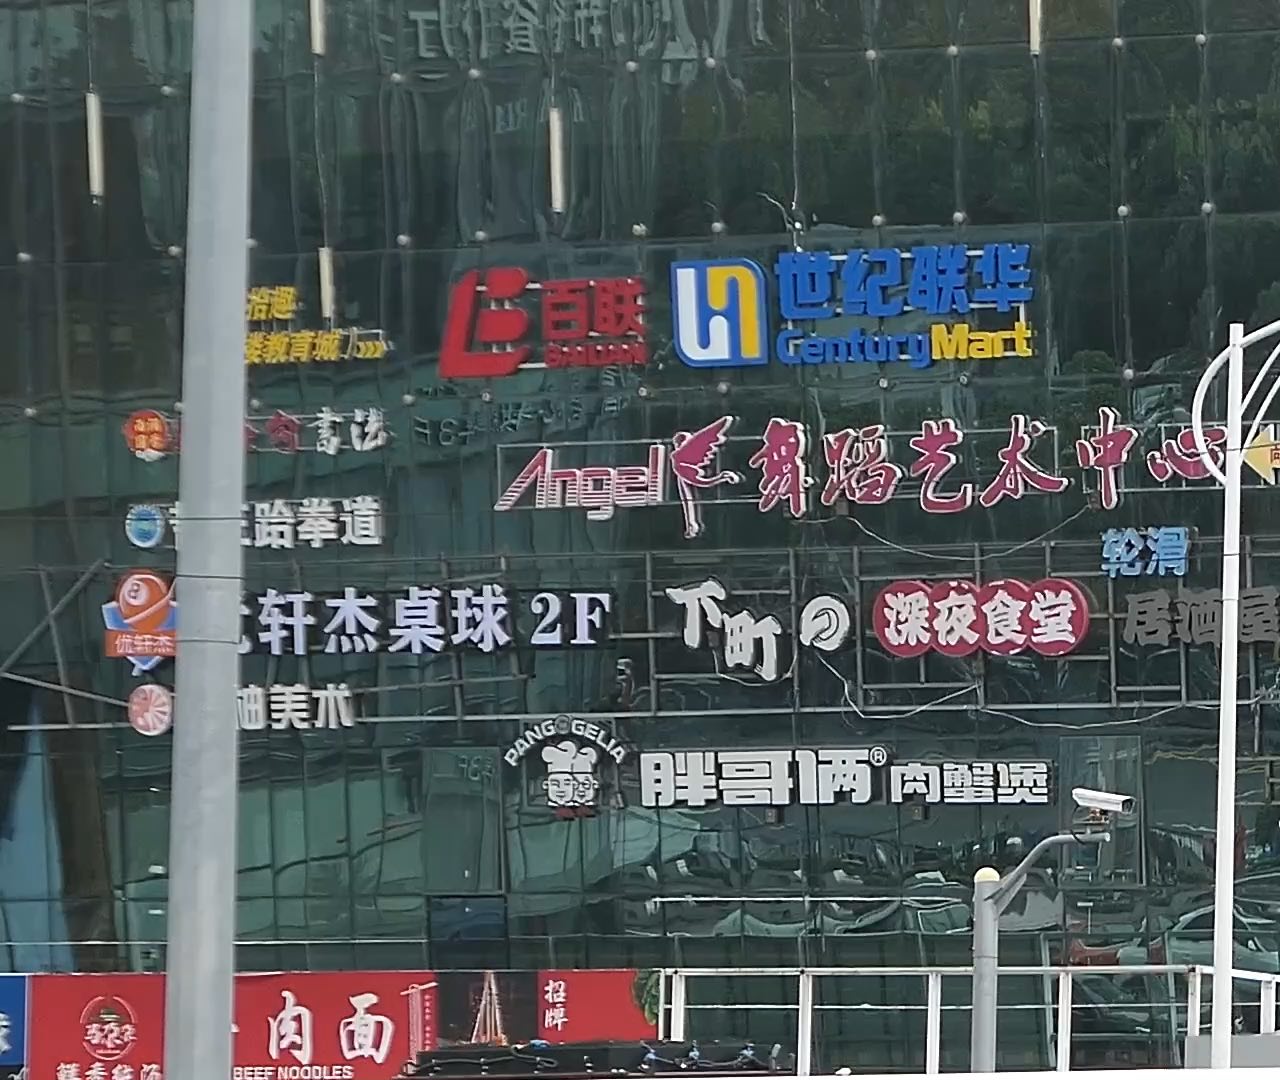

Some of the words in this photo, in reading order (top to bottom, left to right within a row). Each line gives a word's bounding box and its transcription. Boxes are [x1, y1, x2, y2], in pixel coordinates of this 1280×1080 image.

[543, 277, 648, 339] 百联
[775, 244, 1034, 320] 世纪联华
[777, 321, 1035, 369] CenturyMart
[493, 445, 666, 521] Angel
[749, 405, 1228, 518] 舞蹈艺术中心
[1101, 526, 1190, 579] 轮滑
[240, 584, 514, 656] 轩杰桌球
[530, 592, 611, 647] 2F
[882, 590, 1077, 648] 深夜食堂
[1123, 586, 1280, 646] 居酒屋
[503, 716, 555, 767] PANG
[571, 719, 627, 765] GELIA
[640, 749, 870, 808] 胖哥俩
[889, 761, 1048, 806] 肉蟹煲
[232, 990, 395, 1065] 肉面
[544, 979, 569, 1032] 招牌
[233, 1066, 275, 1080] BEEF
[278, 1066, 354, 1080] NOODLES
